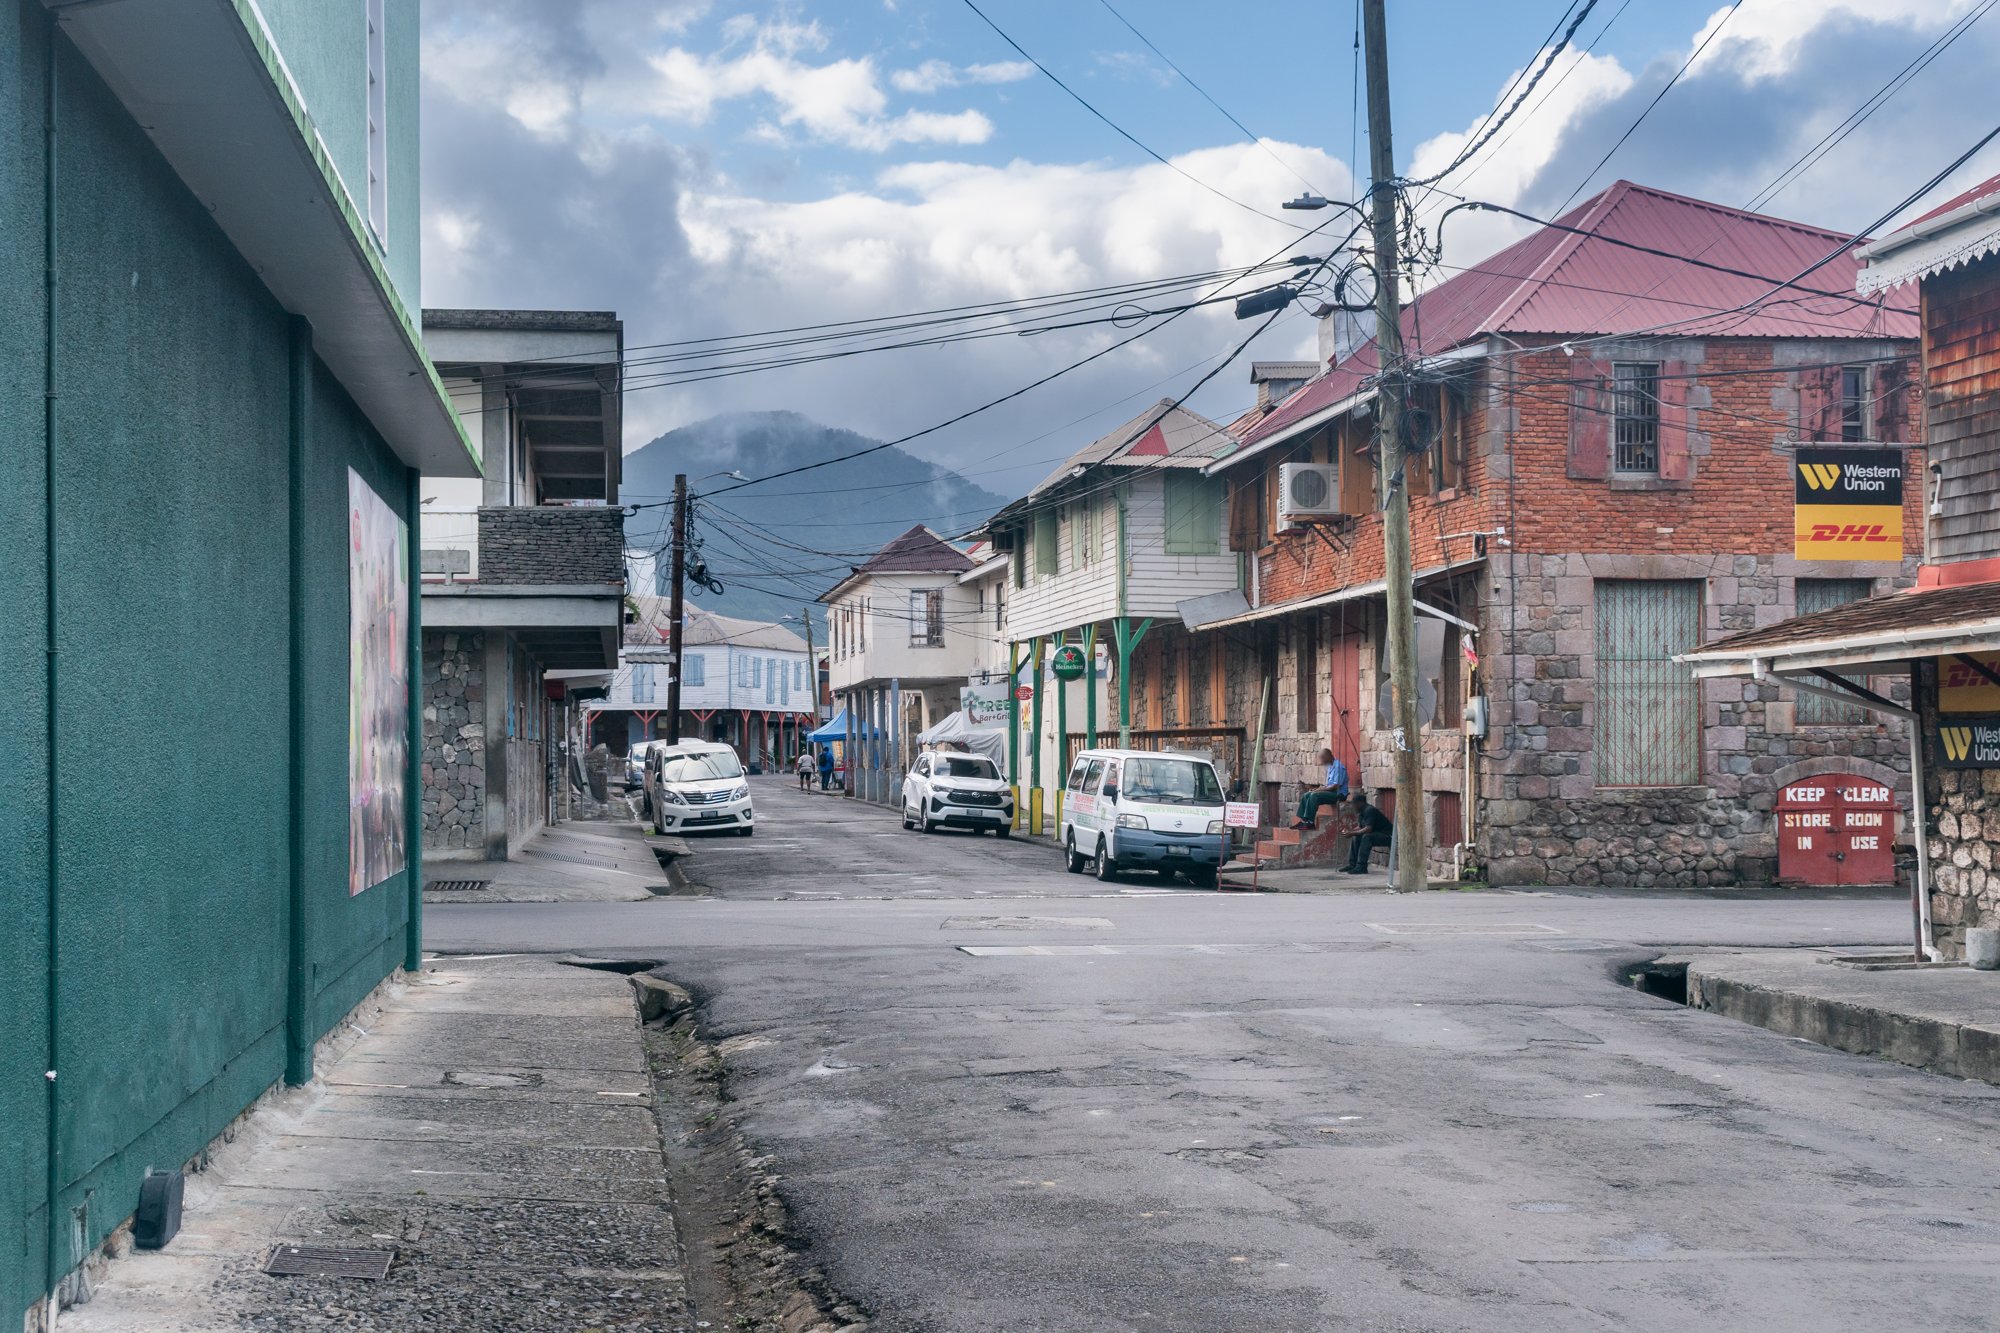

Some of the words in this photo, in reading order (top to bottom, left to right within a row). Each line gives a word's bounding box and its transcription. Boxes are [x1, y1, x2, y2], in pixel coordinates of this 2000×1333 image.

[1843, 464, 1901, 478] Western
[1844, 477, 1885, 491] Union
[1810, 524, 1890, 542] DHL
[1947, 660, 2000, 687] DH
[1785, 787, 1825, 802] KEEP
[1843, 787, 1889, 802] CLEAR
[1784, 813, 1831, 827] STORE
[1845, 813, 1882, 827] ROOM
[1797, 836, 1812, 850] IN
[1851, 836, 1879, 850] USE
